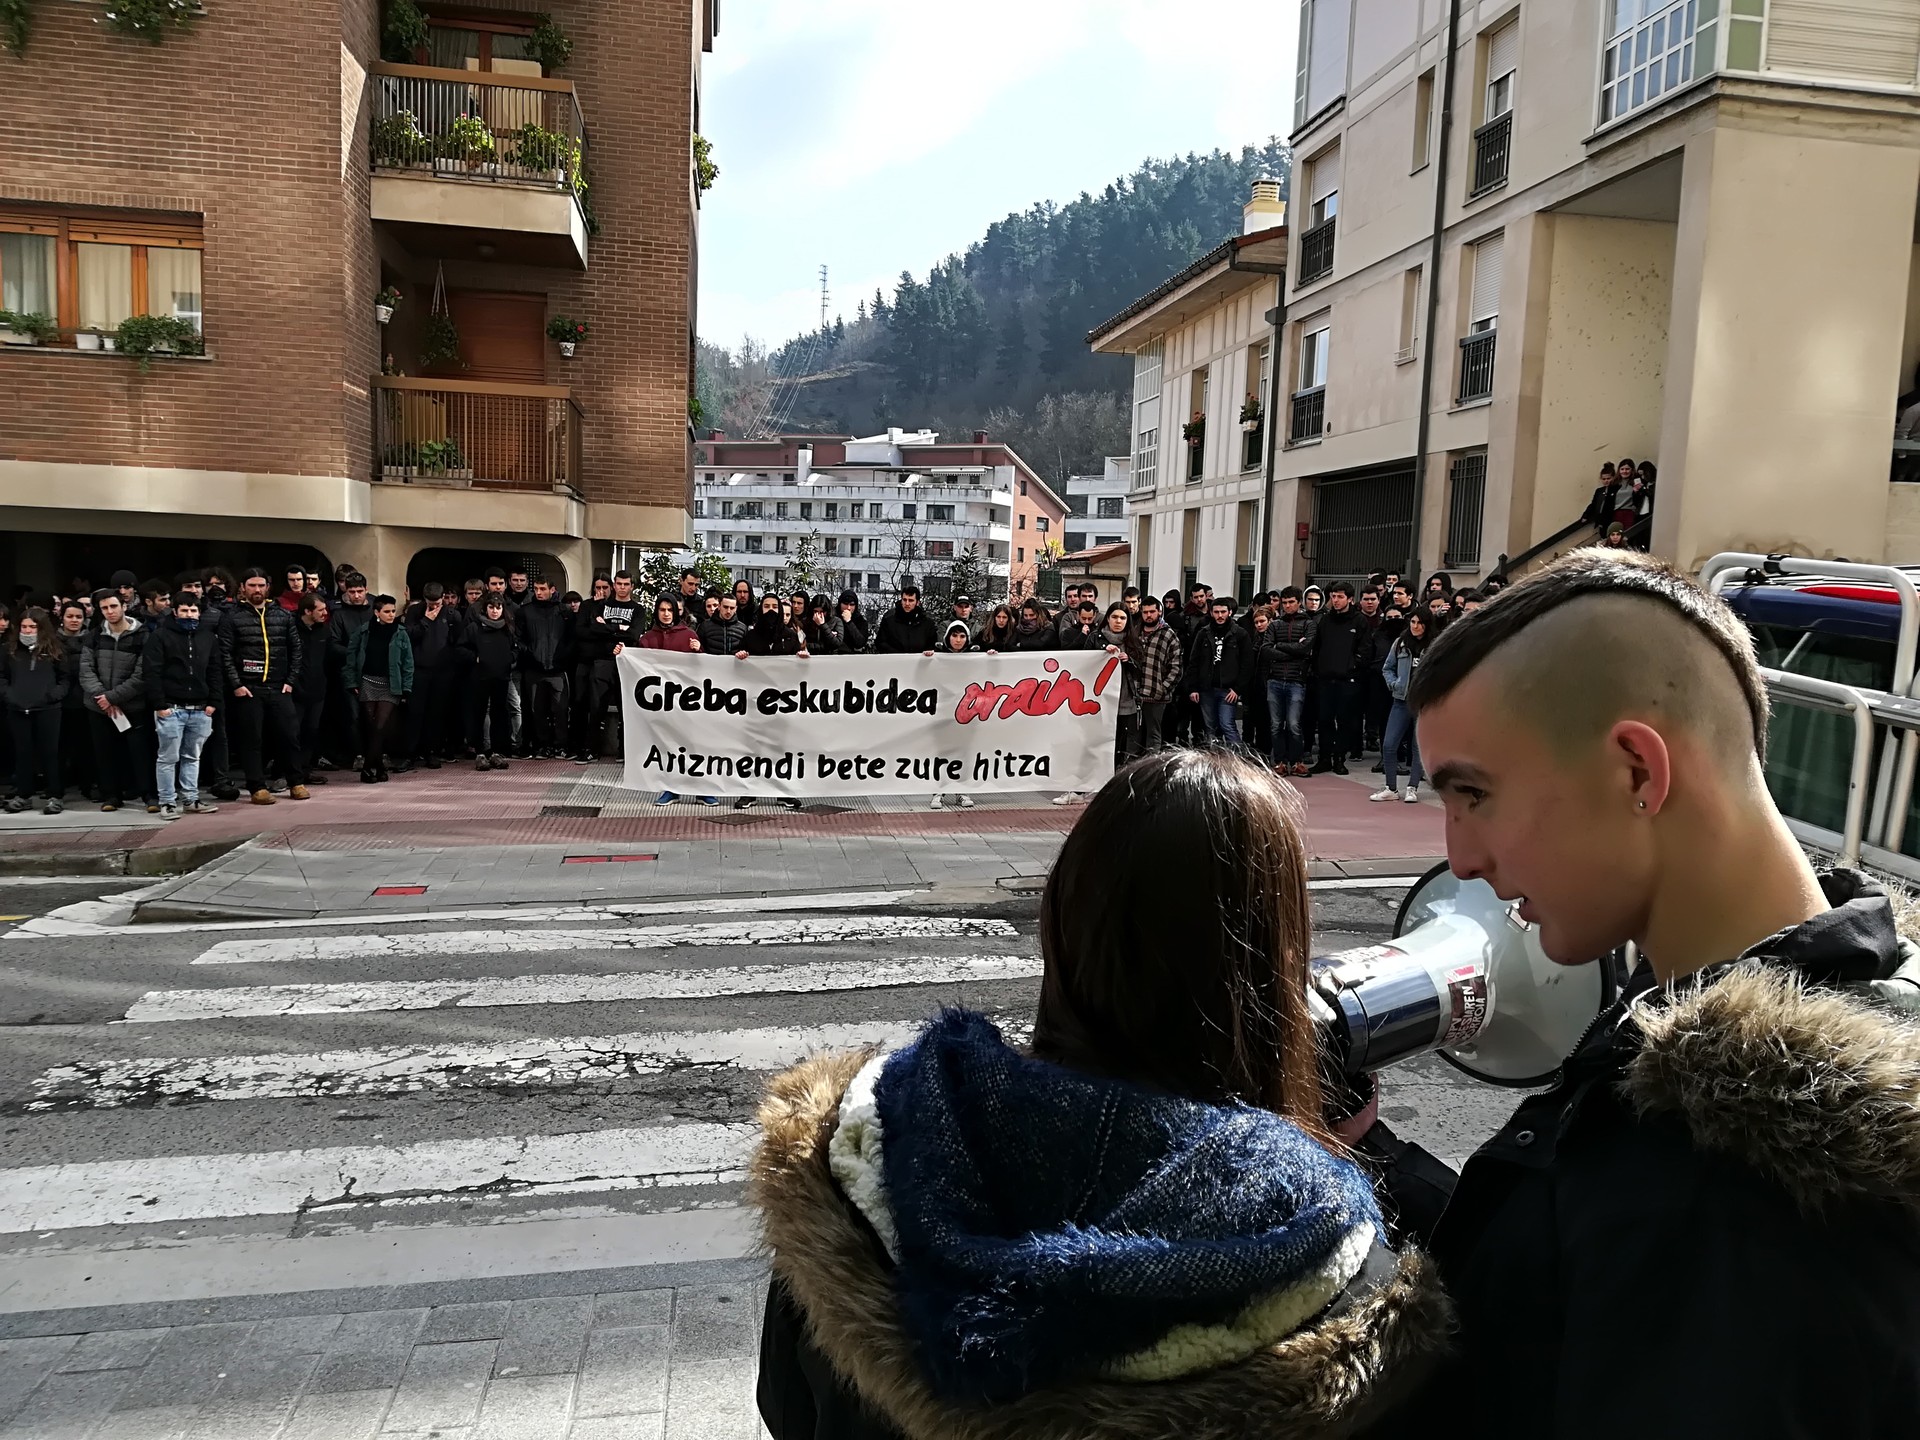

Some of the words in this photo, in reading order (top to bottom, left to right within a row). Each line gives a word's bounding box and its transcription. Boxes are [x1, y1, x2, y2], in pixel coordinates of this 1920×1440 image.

[634, 676, 748, 715] Greba
[756, 678, 938, 715] eskubidea
[643, 745, 805, 780] Arizmendi
[817, 753, 886, 781] bete
[895, 757, 963, 781] zure
[973, 749, 1051, 781] hitza
